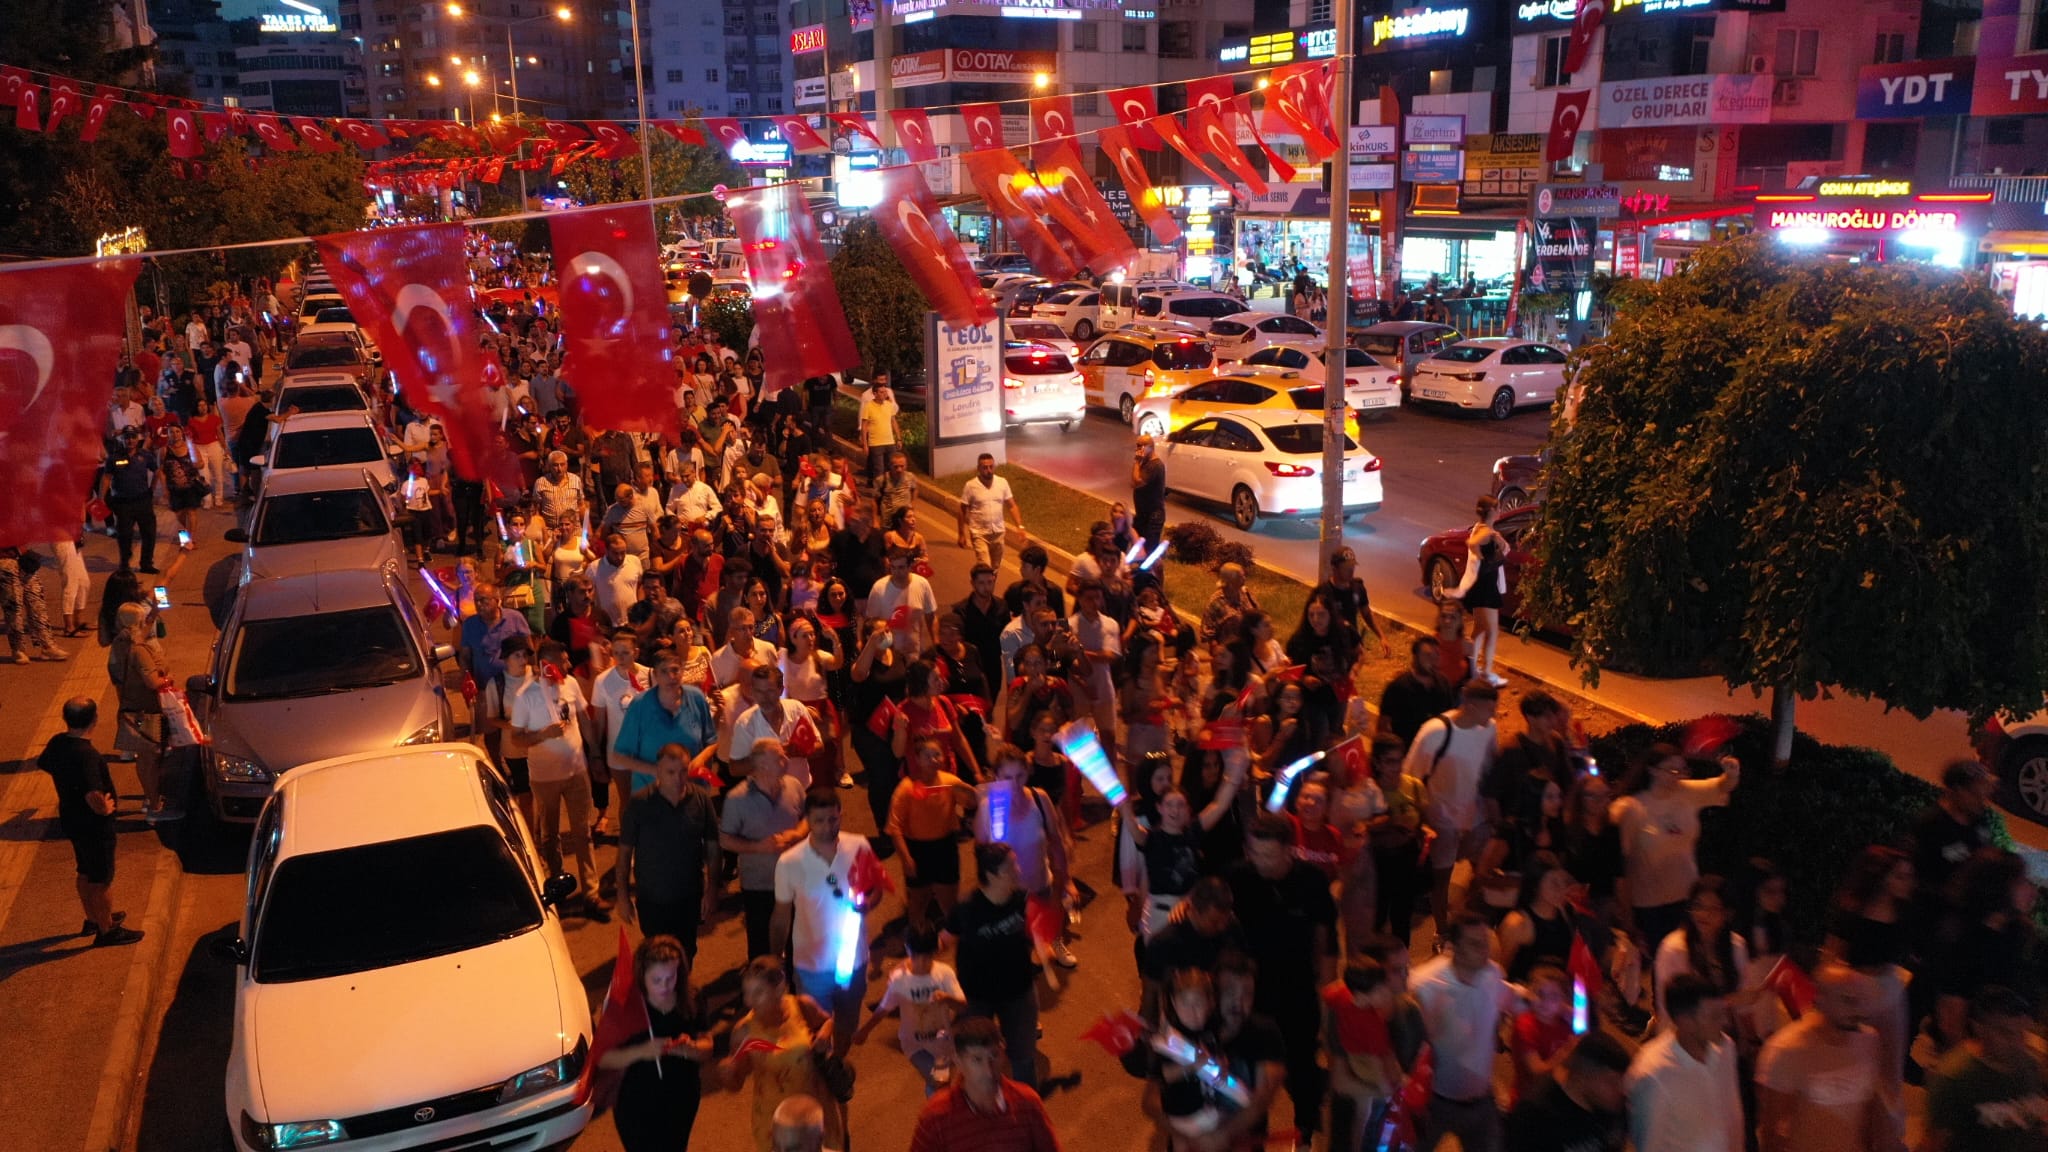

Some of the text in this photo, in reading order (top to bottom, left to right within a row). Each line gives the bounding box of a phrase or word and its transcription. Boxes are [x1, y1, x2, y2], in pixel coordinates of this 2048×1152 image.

[901, 57, 920, 75] OTAY
[974, 51, 1013, 70] OTAY
[1612, 82, 1709, 103] ÖZEL DERECE
[1879, 72, 1953, 106] YDT
[1631, 103, 1707, 120] GRUPLARI
[1350, 142, 1389, 153] kinKURS
[1102, 190, 1127, 200] NES
[1853, 180, 1911, 197] ATEŞİNDE
[1770, 208, 1958, 229] MANSUROĞLU DÖNER
